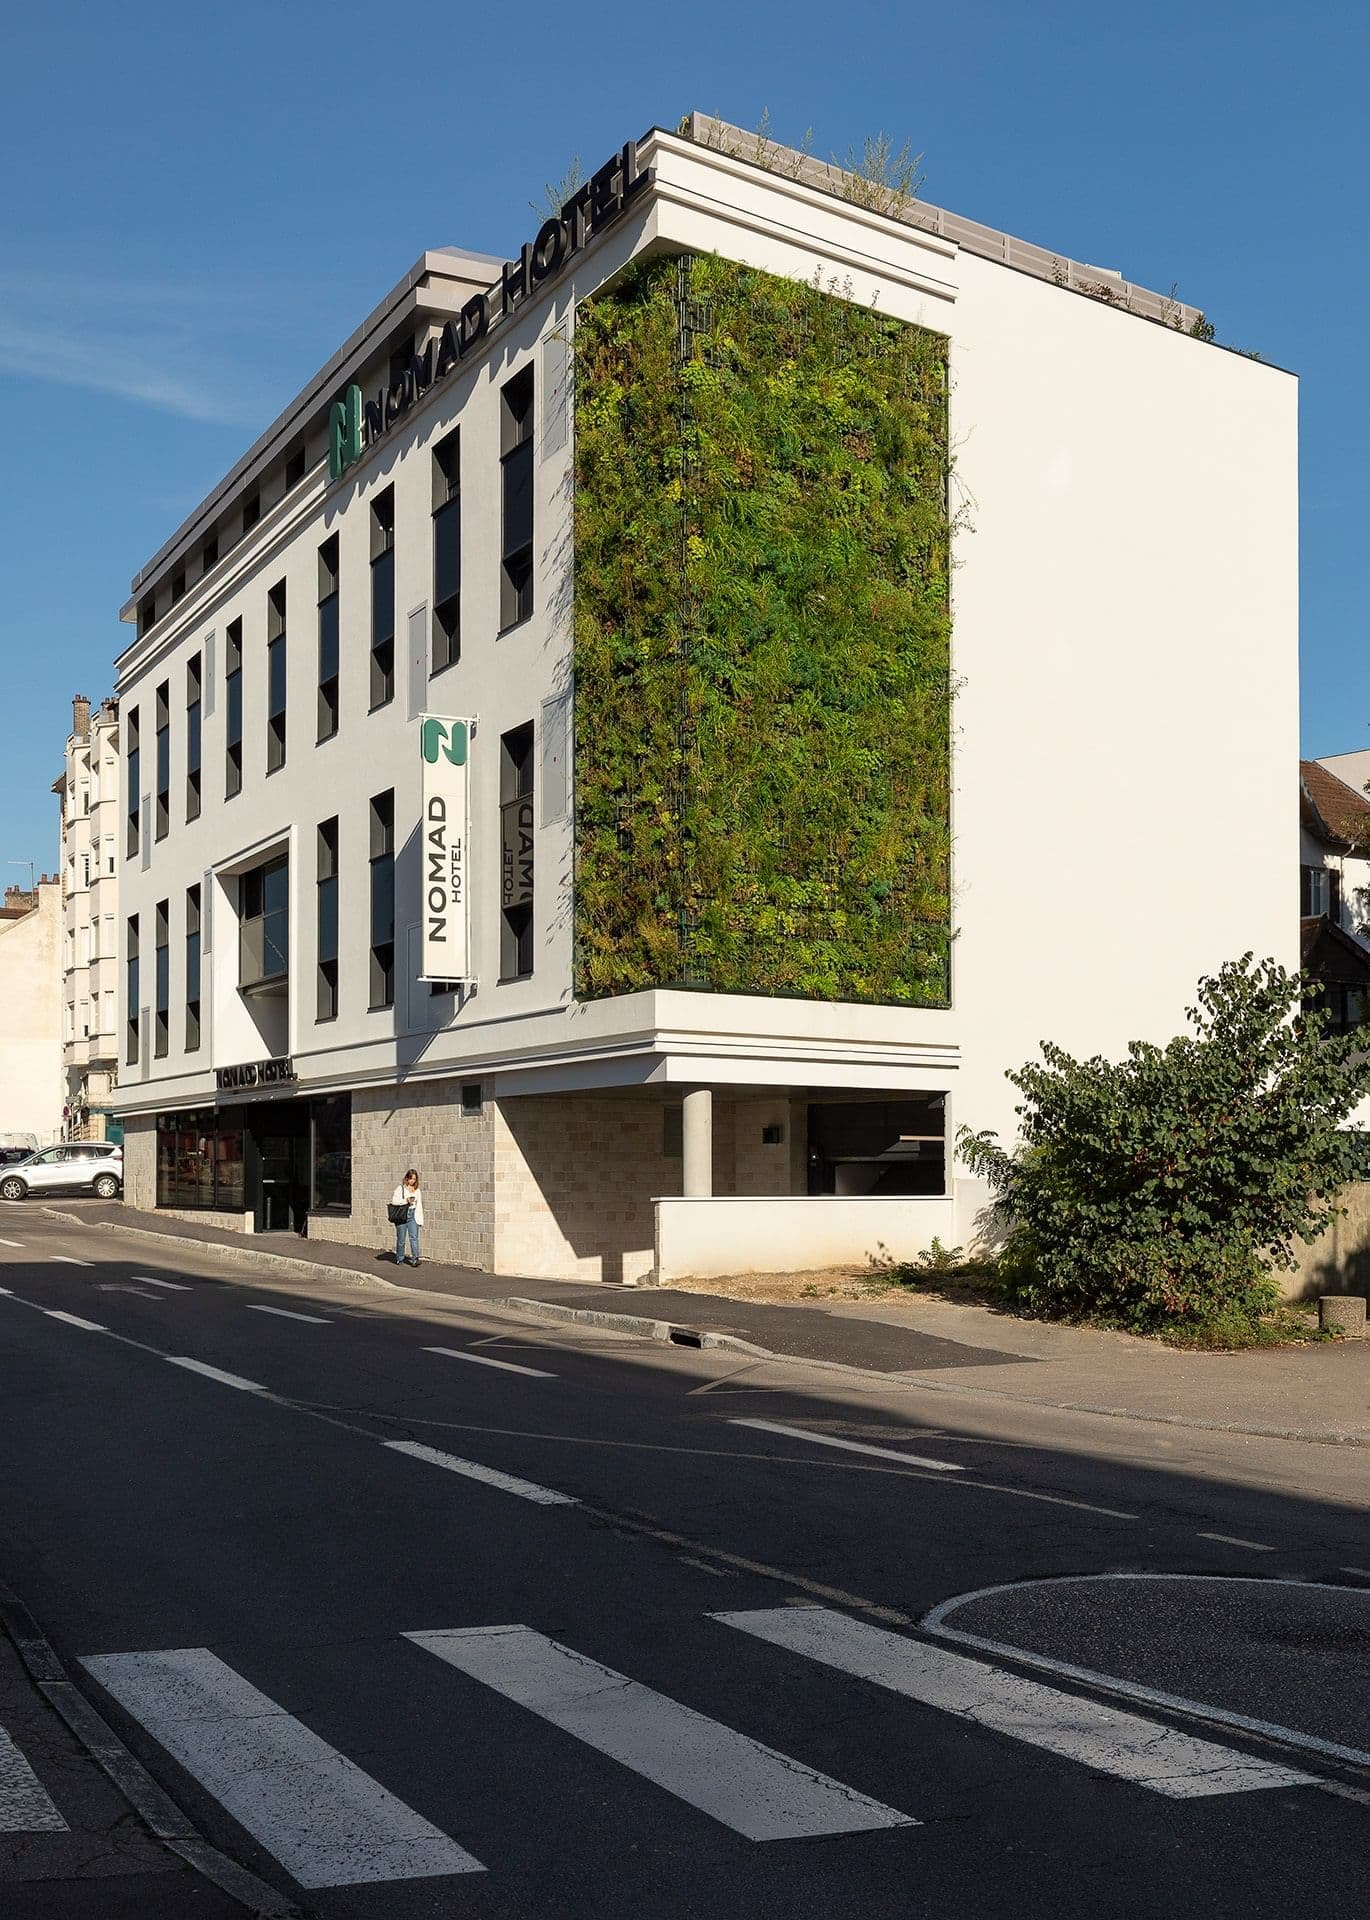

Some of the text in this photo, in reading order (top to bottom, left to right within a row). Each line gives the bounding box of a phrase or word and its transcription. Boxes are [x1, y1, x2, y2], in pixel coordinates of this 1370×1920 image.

[365, 294, 490, 446] NOMAD
[502, 141, 657, 316] HOTEL
[428, 796, 447, 943] NOMAD
[451, 838, 462, 903] HOTEL
